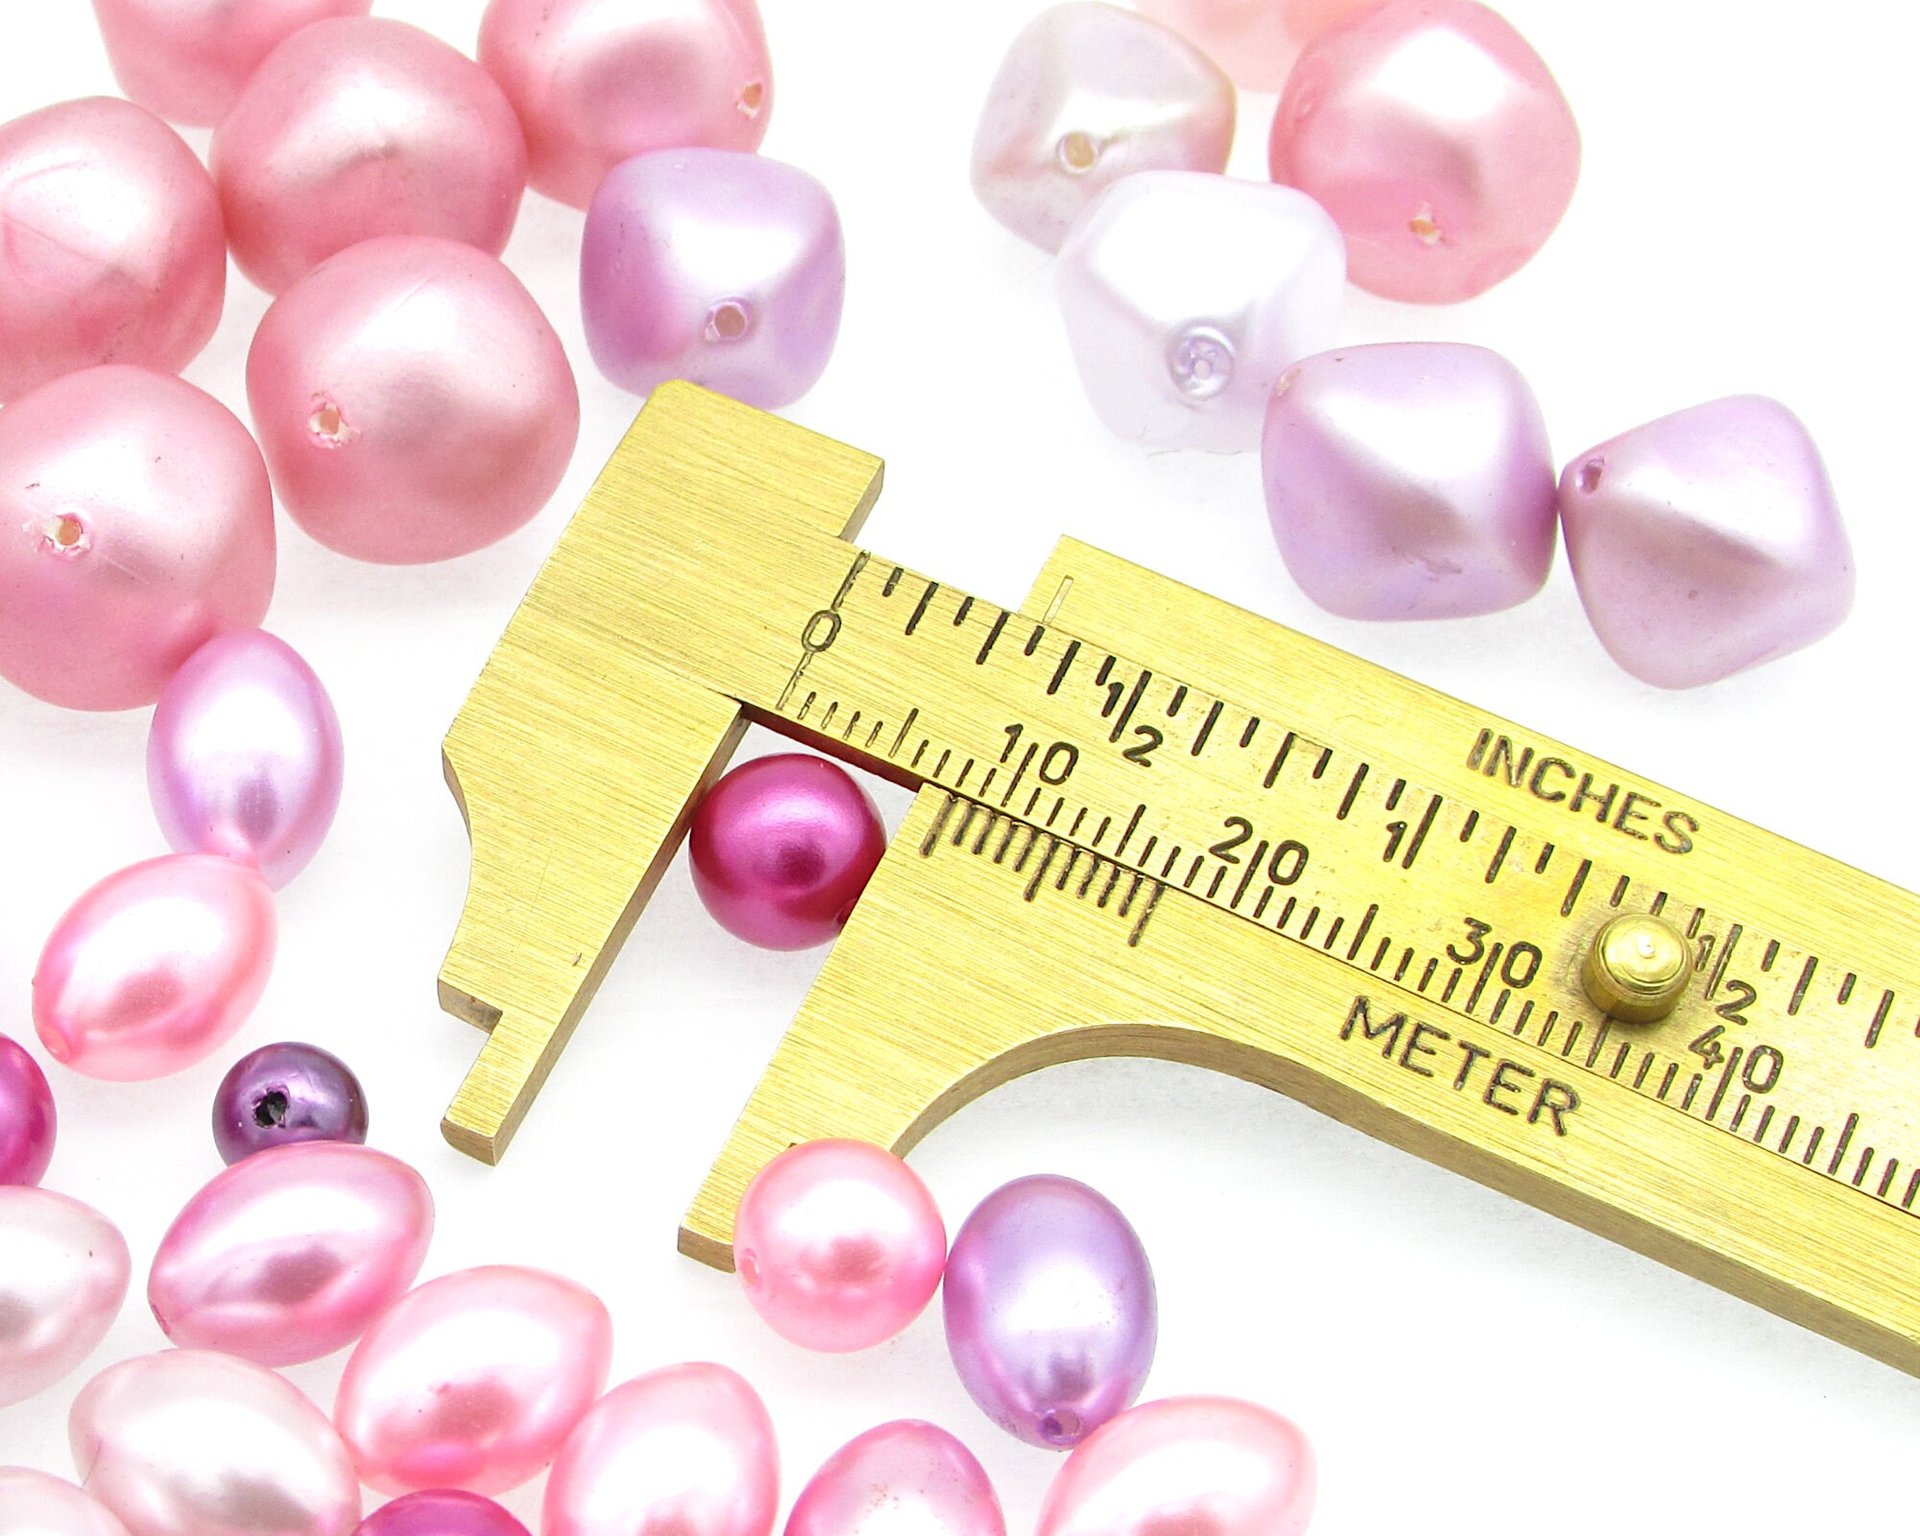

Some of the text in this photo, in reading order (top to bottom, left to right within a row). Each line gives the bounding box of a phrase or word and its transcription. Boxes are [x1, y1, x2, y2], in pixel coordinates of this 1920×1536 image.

[1003, 723, 1080, 787] 10
[1466, 727, 1700, 855] INCHES
[1208, 815, 1310, 887] 20
[1445, 915, 1543, 991] 30
[1339, 994, 1582, 1137] METER
[1688, 1023, 1785, 1095] 40
